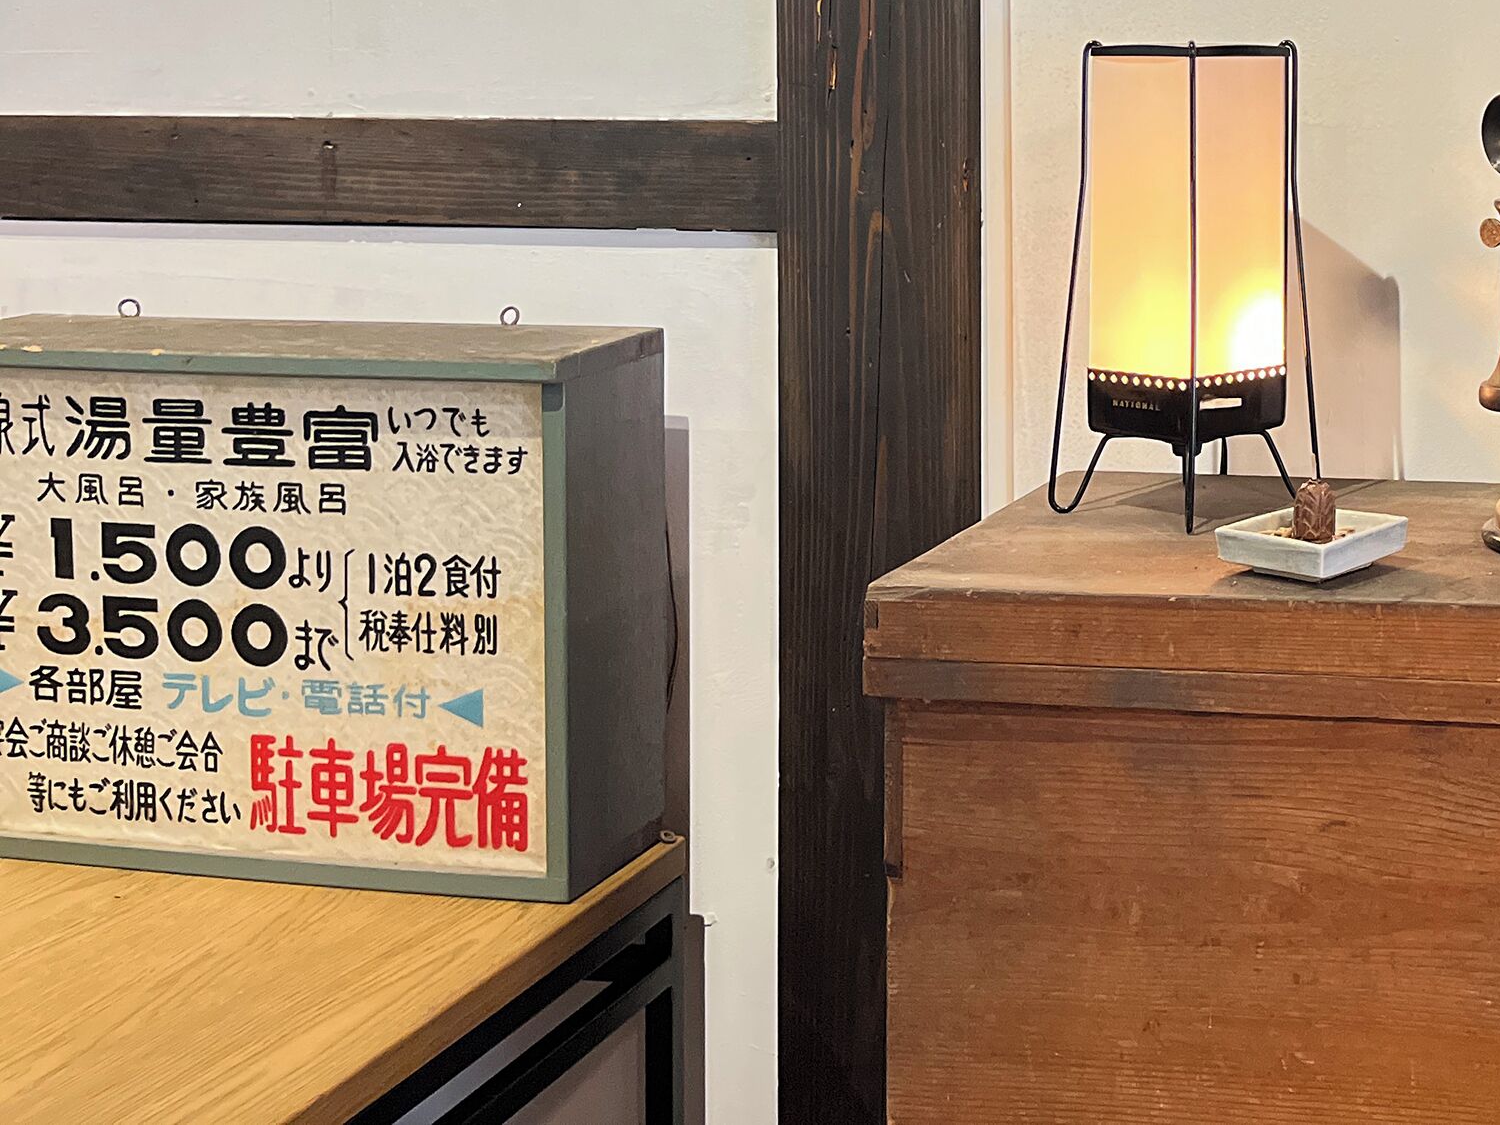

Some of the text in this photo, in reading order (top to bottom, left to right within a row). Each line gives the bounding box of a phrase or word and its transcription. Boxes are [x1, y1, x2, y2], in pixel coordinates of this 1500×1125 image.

[387, 406, 490, 438] いつでも
[1112, 399, 1161, 412] NATIONAL
[392, 441, 528, 475] 入浴できます
[358, 609, 498, 655] 税奉仕料別
[0, 716, 223, 773] 会ご商談ご休憩ご会合
[27, 771, 241, 824] 等にもご利用ください
[250, 734, 528, 852] 駐車場完備
